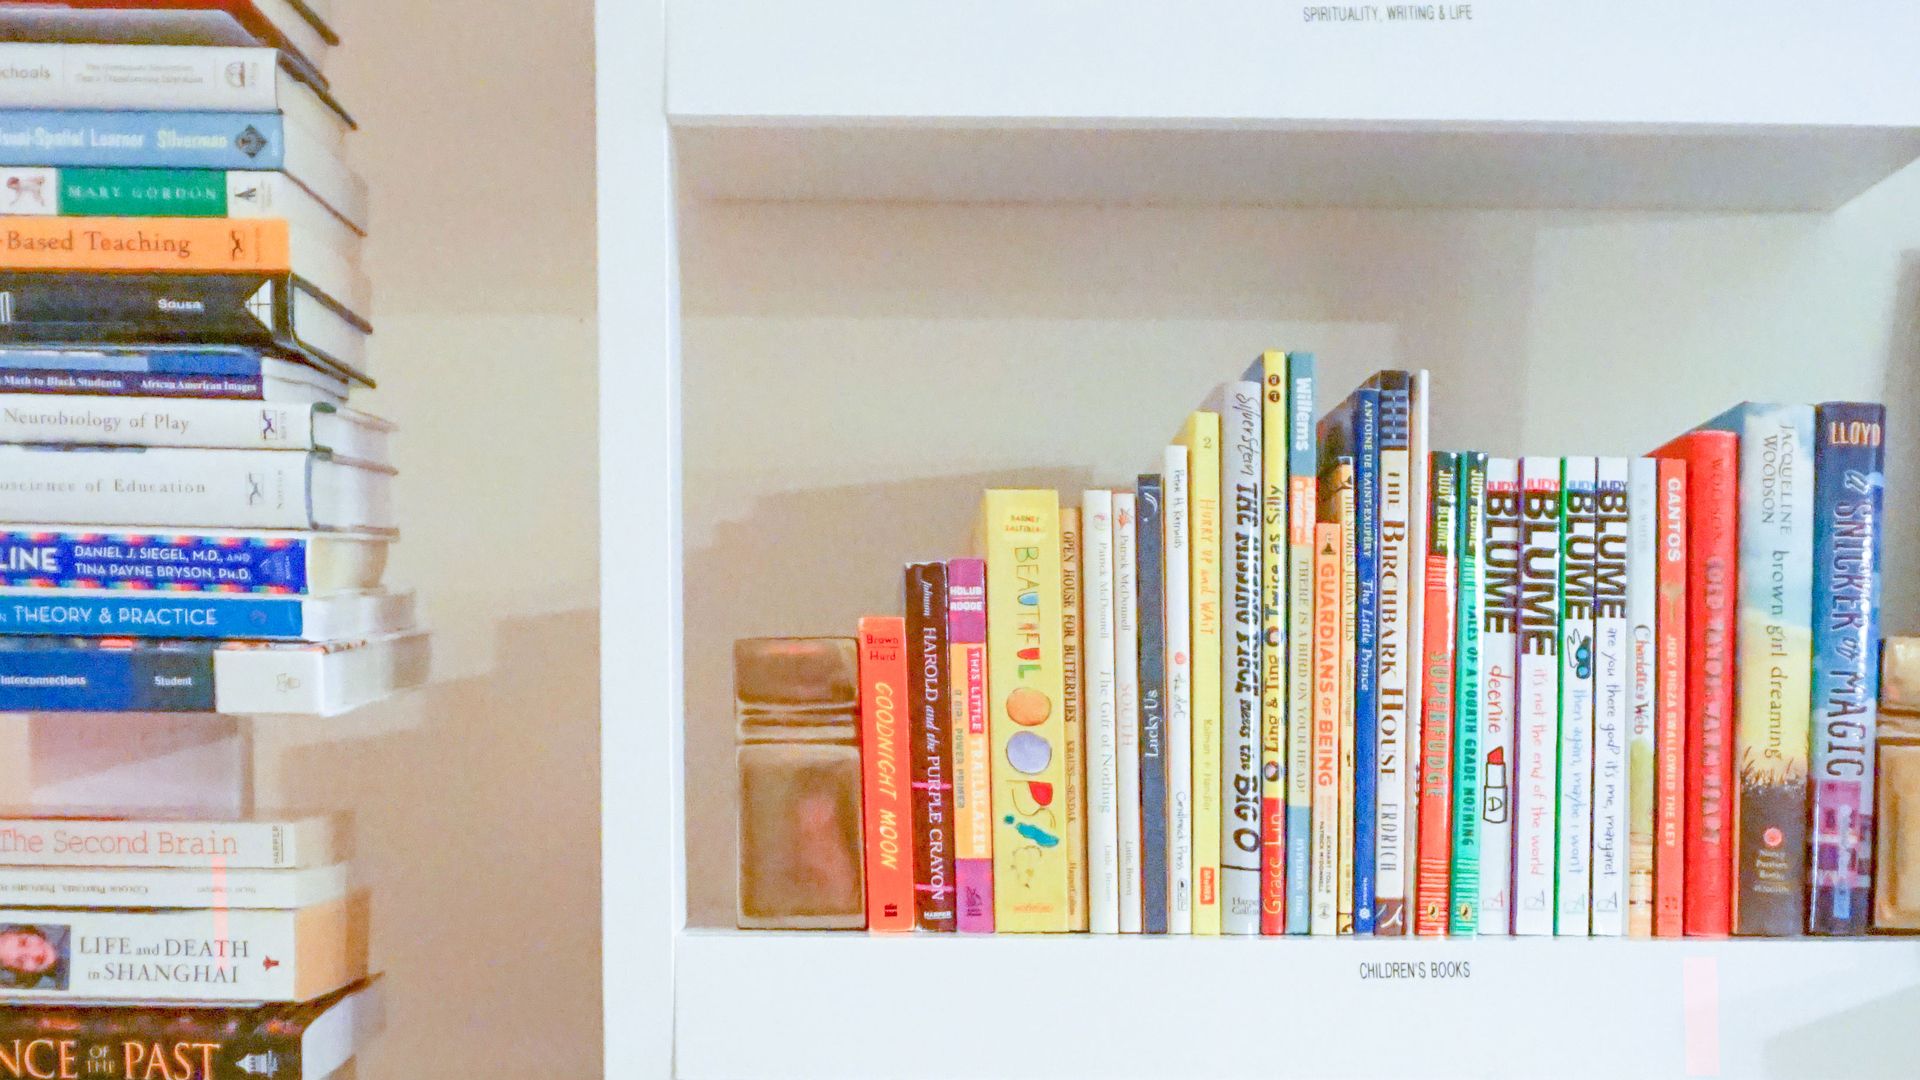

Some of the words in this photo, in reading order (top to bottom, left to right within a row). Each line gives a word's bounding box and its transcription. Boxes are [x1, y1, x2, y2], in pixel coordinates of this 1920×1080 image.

[1303, 6, 1383, 22] SPIRITUALITY,
[1387, 5, 1434, 20] WRITING
[1438, 5, 1446, 20] &
[1449, 4, 1473, 20] LIFE
[90, 128, 144, 148] Learner
[157, 128, 228, 149] Silverman
[68, 186, 121, 199] MARY
[132, 186, 216, 200] GORDON
[83, 230, 192, 258] Teaching
[158, 298, 203, 311] Sousa
[4, 376, 31, 387] Math
[34, 377, 44, 387] to
[47, 376, 76, 388] Black
[78, 377, 122, 388] Students
[141, 380, 176, 390] African
[177, 380, 223, 391] American
[224, 381, 258, 393] Images
[4, 408, 121, 431] Neurobiology
[129, 412, 146, 429] of
[154, 413, 190, 434] Play
[1295, 377, 1312, 451] Willems
[1364, 400, 1373, 450] ANTOINE
[1232, 393, 1260, 476] Silverstein
[1831, 421, 1881, 447] LLOYD
[1364, 454, 1373, 468] DE
[85, 479, 101, 492] of
[114, 480, 206, 494] Education
[1438, 470, 1451, 500] JUDY
[1471, 469, 1484, 500] JUDY
[1487, 480, 1520, 491] JUDY
[1527, 479, 1560, 491] JUDY
[1601, 480, 1627, 491] JUDY
[1762, 434, 1778, 524] WOODSON
[1778, 425, 1795, 536] JACQUELINE
[1200, 500, 1215, 543] HURRY
[1236, 482, 1258, 527] THE
[1266, 484, 1283, 525] Silly
[1667, 477, 1681, 562] GANTOS
[1437, 505, 1450, 546] BLUME
[1469, 505, 1481, 546] BLUME
[74, 545, 123, 559] DANIEL
[125, 547, 137, 560] J.
[140, 548, 189, 561] SIEGEL,
[227, 553, 250, 563] AND
[1063, 531, 1075, 562] OPEN
[1120, 534, 1129, 568] Patrick
[1201, 549, 1213, 564] UP
[1270, 533, 1281, 554] as
[1345, 520, 1355, 566] STORIES
[1565, 491, 1597, 620] BLUME
[1597, 491, 1627, 619] BLUME
[75, 562, 106, 575] TINA
[110, 563, 153, 577] PAYNE
[157, 565, 216, 579] BRYSON,
[1235, 532, 1259, 624] MISSING
[1485, 491, 1520, 634] BLUME
[1521, 491, 1559, 656] BLUME
[1831, 503, 1873, 630] SNICKER
[1063, 570, 1076, 608] HOUSE
[1200, 569, 1215, 595] and
[1265, 564, 1280, 620] Twice
[1299, 560, 1309, 605] THERE
[1344, 570, 1355, 606] JULIAN
[1362, 579, 1373, 605] The
[1772, 550, 1790, 616] brown
[14, 605, 92, 623] THEORY
[99, 607, 112, 624] &
[119, 608, 218, 626] PRACTICE
[1015, 546, 1042, 679] BEAUTIFUL
[1099, 581, 1110, 639] McDonnell
[1120, 573, 1131, 631] McDonnell
[866, 634, 899, 644] Brown
[1063, 614, 1076, 638] FOR
[1319, 562, 1335, 693] GUARDIANS
[1362, 609, 1373, 644] Little
[1467, 605, 1479, 641] TALES
[1606, 628, 1618, 647] are
[870, 650, 896, 661] Hurd
[1466, 647, 1478, 663] OF
[1667, 634, 1677, 665] JOEY
[1766, 624, 1788, 657] girl
[1835, 637, 1858, 661] of
[923, 627, 938, 701] HAROLD
[970, 651, 981, 680] THIS
[1235, 630, 1259, 697] PIECE
[1265, 655, 1278, 693] Ting
[1299, 644, 1309, 678] BIRD
[1361, 648, 1373, 691] Prince
[1467, 668, 1478, 677] A
[1601, 651, 1617, 676] you
[1633, 625, 1651, 700] Charlotte's
[154, 675, 193, 686] Student
[1063, 645, 1077, 722] BUTTERFLIES
[1100, 672, 1111, 696] The
[1298, 682, 1308, 700] ON
[1666, 670, 1677, 708] PIGZA
[971, 687, 982, 730] LITTLE
[1100, 702, 1111, 729] Gift
[1267, 697, 1277, 708] &
[1322, 697, 1332, 715] OF
[1465, 683, 1478, 733] FOURTH
[1488, 665, 1512, 733] deenie
[1534, 693, 1547, 715] not
[1573, 689, 1587, 721] then
[1606, 684, 1622, 717] there
[1765, 666, 1789, 760] dreaming
[925, 705, 941, 731] and
[1265, 715, 1279, 753] Ling
[1297, 707, 1307, 744] YOUR
[1426, 652, 1448, 799] SUPERFUDGE
[1634, 702, 1650, 735] Web
[1827, 671, 1868, 777] MAGIC
[875, 681, 897, 800] GOODNIGHT
[926, 732, 941, 752] the
[1101, 734, 1111, 750] of
[1144, 713, 1159, 758] Lucky
[1533, 724, 1547, 747] the
[1666, 712, 1676, 791] SWALLOWED
[1240, 744, 1253, 770] the
[1319, 720, 1334, 786] BEING
[1464, 738, 1477, 781] GRADE
[1531, 752, 1545, 779] end
[1100, 753, 1112, 814] Nothing
[1297, 750, 1307, 793] HEAD!
[927, 756, 942, 823] PURPLE
[971, 739, 986, 855] TRAILBLAZER
[1234, 774, 1259, 822] BIG
[1533, 784, 1546, 798] of
[1565, 772, 1587, 818] maybe
[1665, 795, 1676, 817] THE
[1264, 814, 1281, 846] Lin
[1463, 788, 1476, 846] NOTHING
[1533, 807, 1547, 828] the
[1, 829, 44, 853] The
[53, 829, 149, 854] Second
[158, 831, 238, 855] Brain
[878, 809, 898, 871] MOON
[1233, 828, 1260, 853] O
[1665, 823, 1676, 847] KEY
[929, 829, 944, 900] CRAYON
[1531, 835, 1544, 875] world
[1263, 857, 1281, 914] Grace
[80, 937, 130, 956] LIFE
[136, 943, 160, 957] and
[164, 939, 249, 958] DEATH
[88, 970, 100, 980] in
[103, 964, 240, 984] SHANGHAI
[1360, 962, 1426, 979] CHILDREN'S
[1431, 961, 1471, 978] BOOKS
[122, 1041, 223, 1080] PAST
